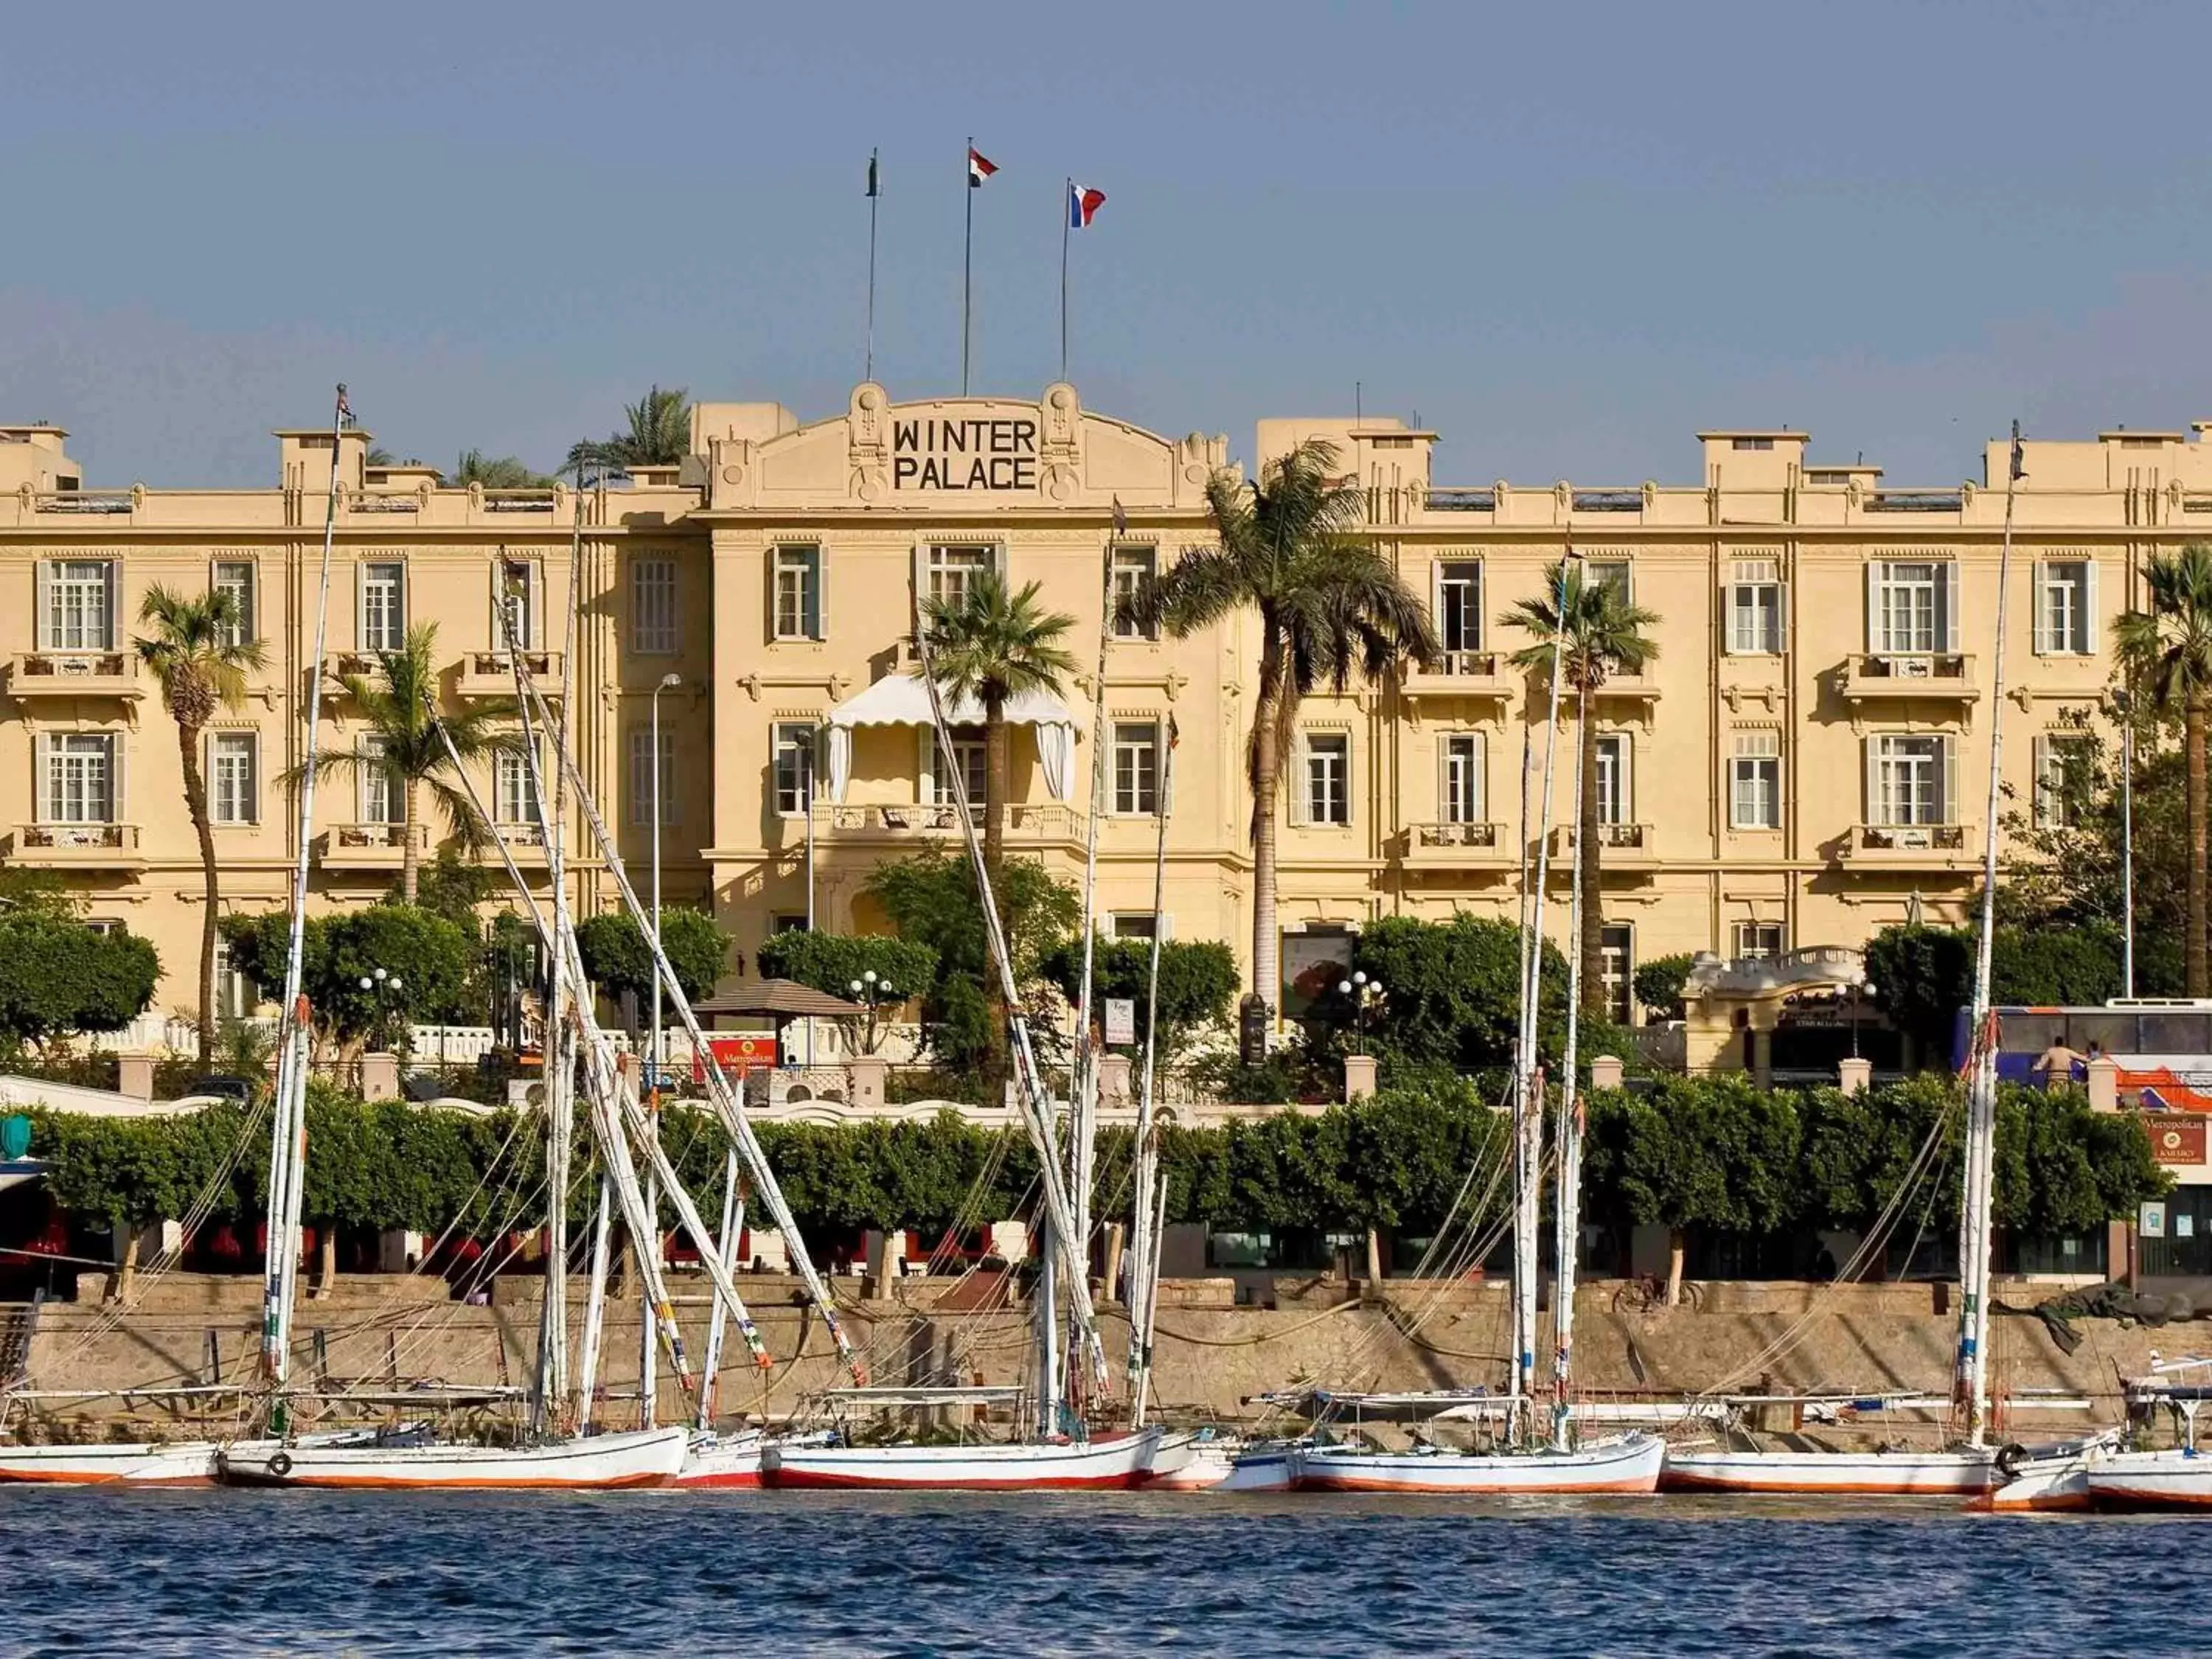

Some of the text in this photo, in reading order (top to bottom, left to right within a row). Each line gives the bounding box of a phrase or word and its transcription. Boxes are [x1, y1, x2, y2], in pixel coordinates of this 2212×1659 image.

[894, 420, 1036, 452] WINTER
[894, 456, 1036, 490] PALACE
[2143, 1117, 2203, 1130] Metropolitan
